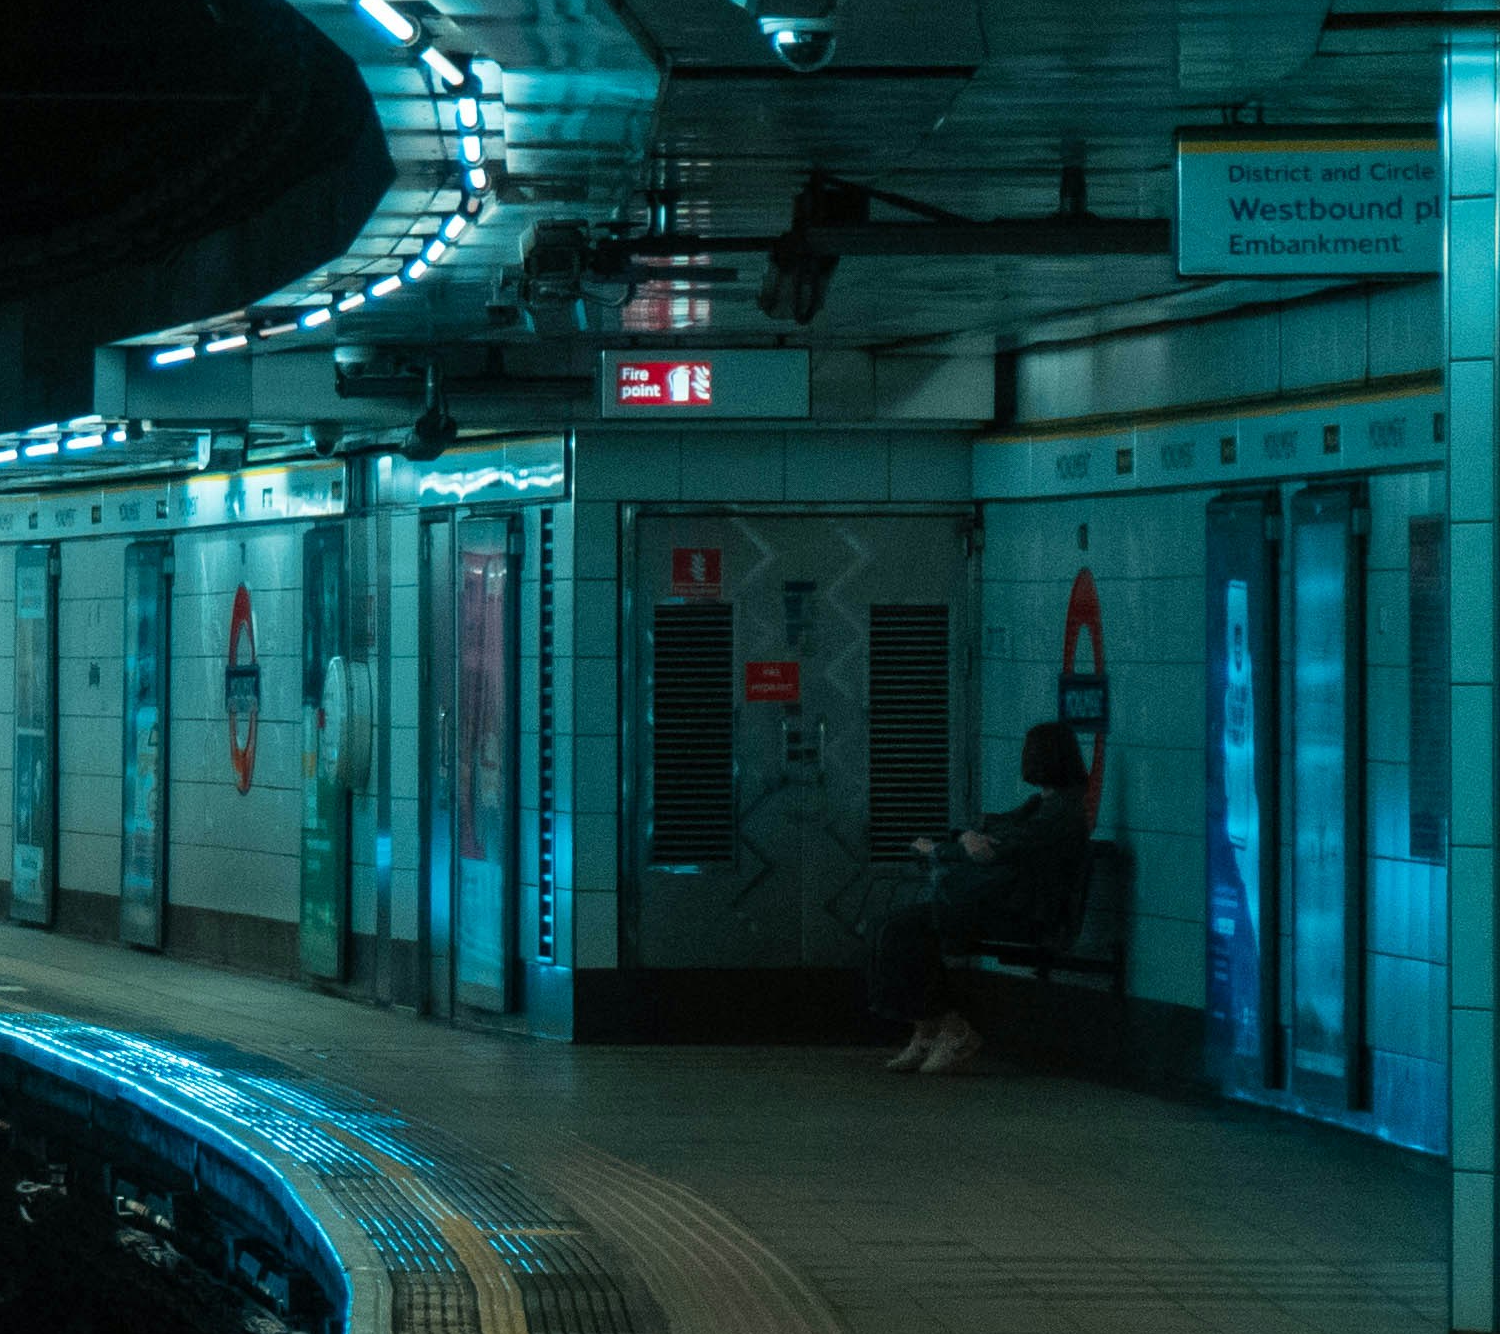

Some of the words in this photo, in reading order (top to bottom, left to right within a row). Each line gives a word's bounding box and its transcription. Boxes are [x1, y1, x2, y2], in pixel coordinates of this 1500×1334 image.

[1228, 163, 1311, 184] District
[1322, 164, 1362, 183] and
[1367, 162, 1436, 182] Circle
[1228, 195, 1404, 223] Westbound
[1228, 233, 1402, 256] Embankment
[622, 366, 649, 381] Fire
[622, 383, 661, 399] point
